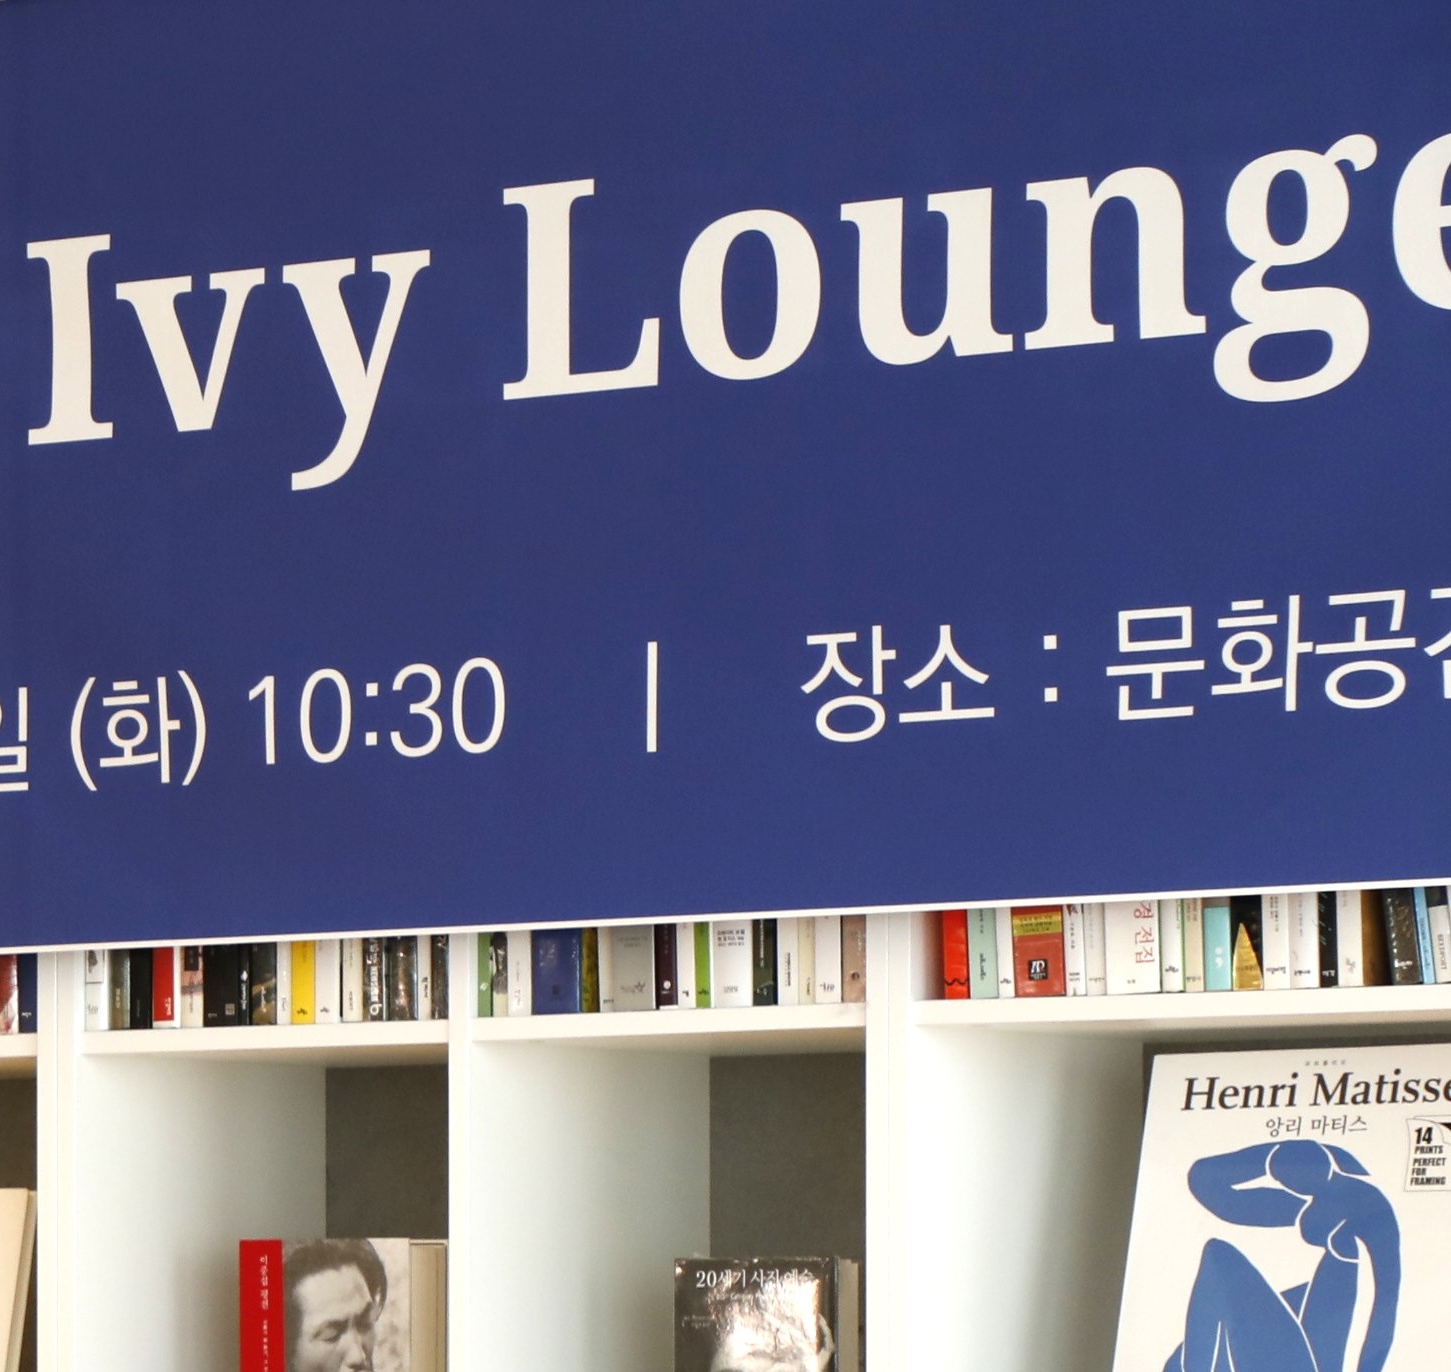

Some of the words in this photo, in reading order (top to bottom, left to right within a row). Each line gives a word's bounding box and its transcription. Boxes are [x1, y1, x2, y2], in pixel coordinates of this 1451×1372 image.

[27, 234, 430, 490] Ivy
[71, 671, 206, 791] (화)
[249, 658, 505, 764] 10:30
[801, 625, 994, 742] 장소
[1181, 1071, 1300, 1112] Henri
[1266, 1116, 1302, 1138] 앙리
[1311, 1115, 1369, 1135] 마티스
[1413, 1127, 1434, 1145] 14
[1413, 1146, 1444, 1156] PRINTS
[1412, 1157, 1446, 1168] PERFECT
[1409, 1176, 1447, 1187] FRAMING
[1411, 1168, 1427, 1177] FOR
[695, 1268, 747, 1289] 20세기
